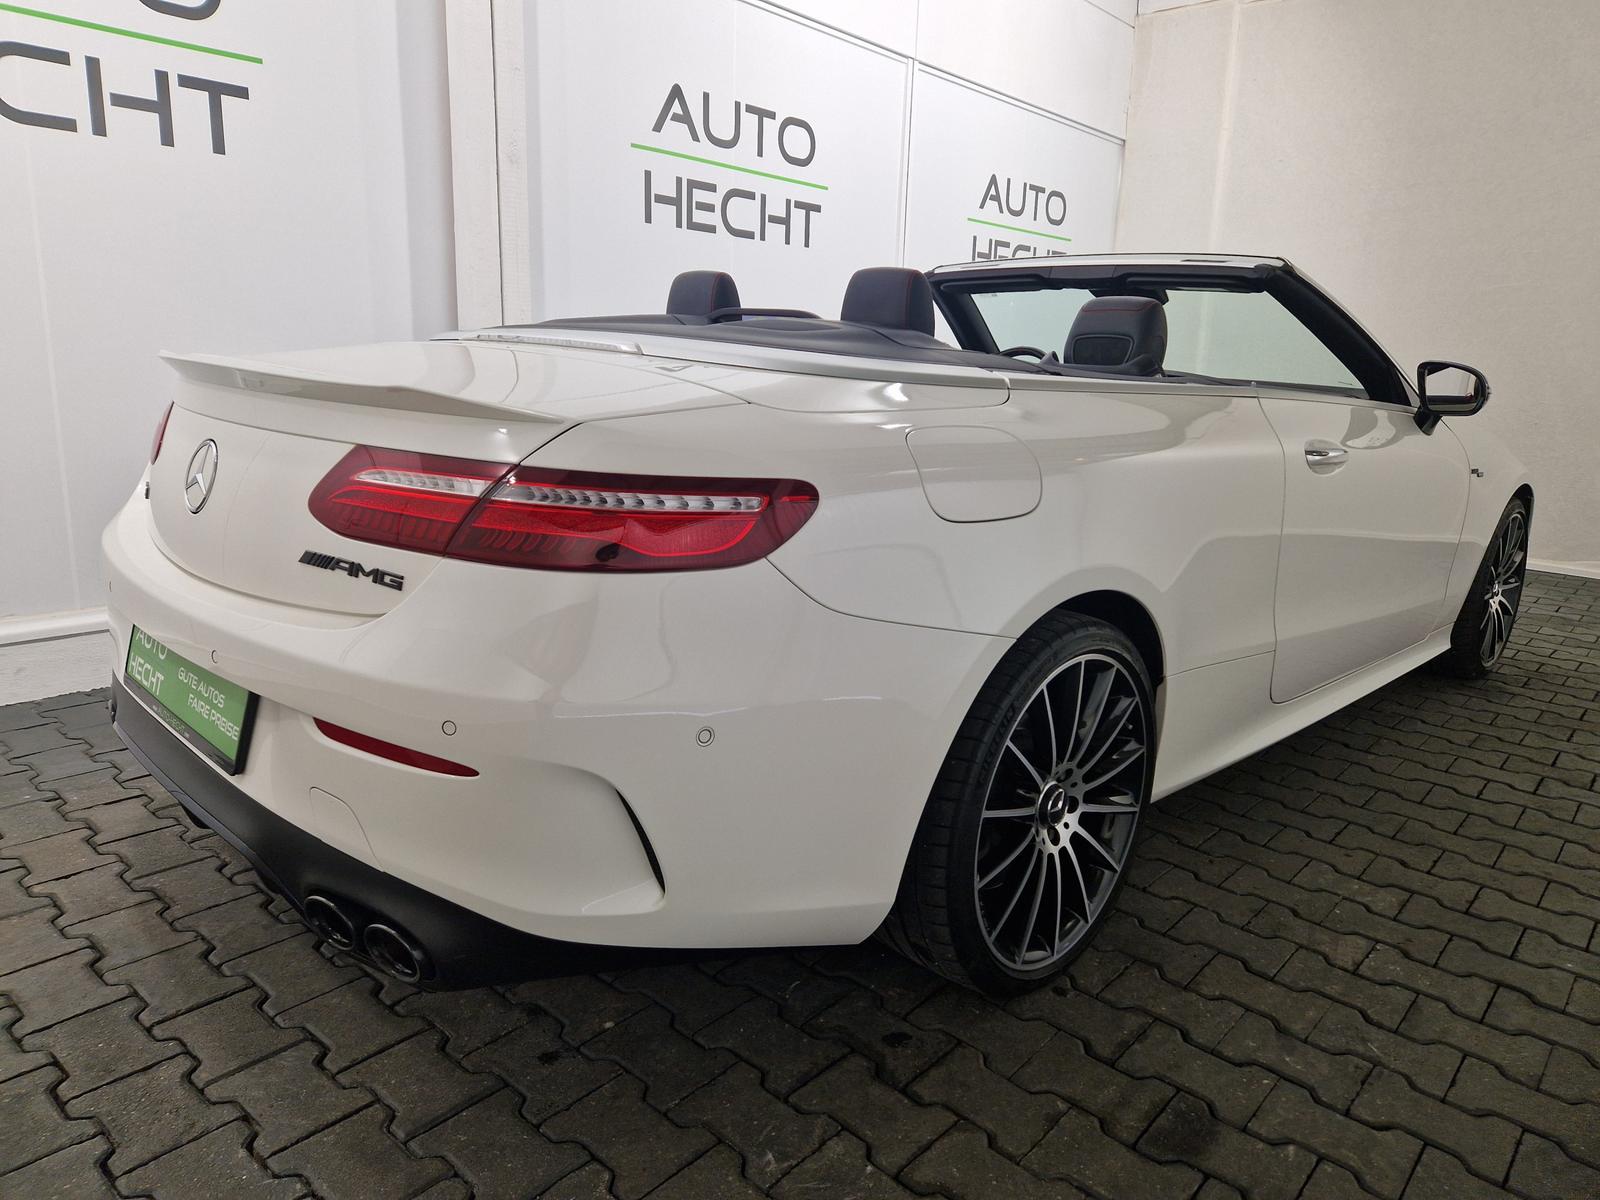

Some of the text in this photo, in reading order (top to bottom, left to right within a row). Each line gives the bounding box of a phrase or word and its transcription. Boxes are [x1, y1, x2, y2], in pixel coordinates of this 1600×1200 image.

[652, 83, 816, 167] AUTO
[644, 169, 821, 248] HECHT
[979, 173, 1067, 226] AUTO
[329, 556, 405, 592] AMG
[129, 652, 164, 695] HECHT
[178, 666, 226, 708] GUTE AUTOS
[188, 694, 209, 719] FAIRE
[210, 709, 239, 740] PREISE
